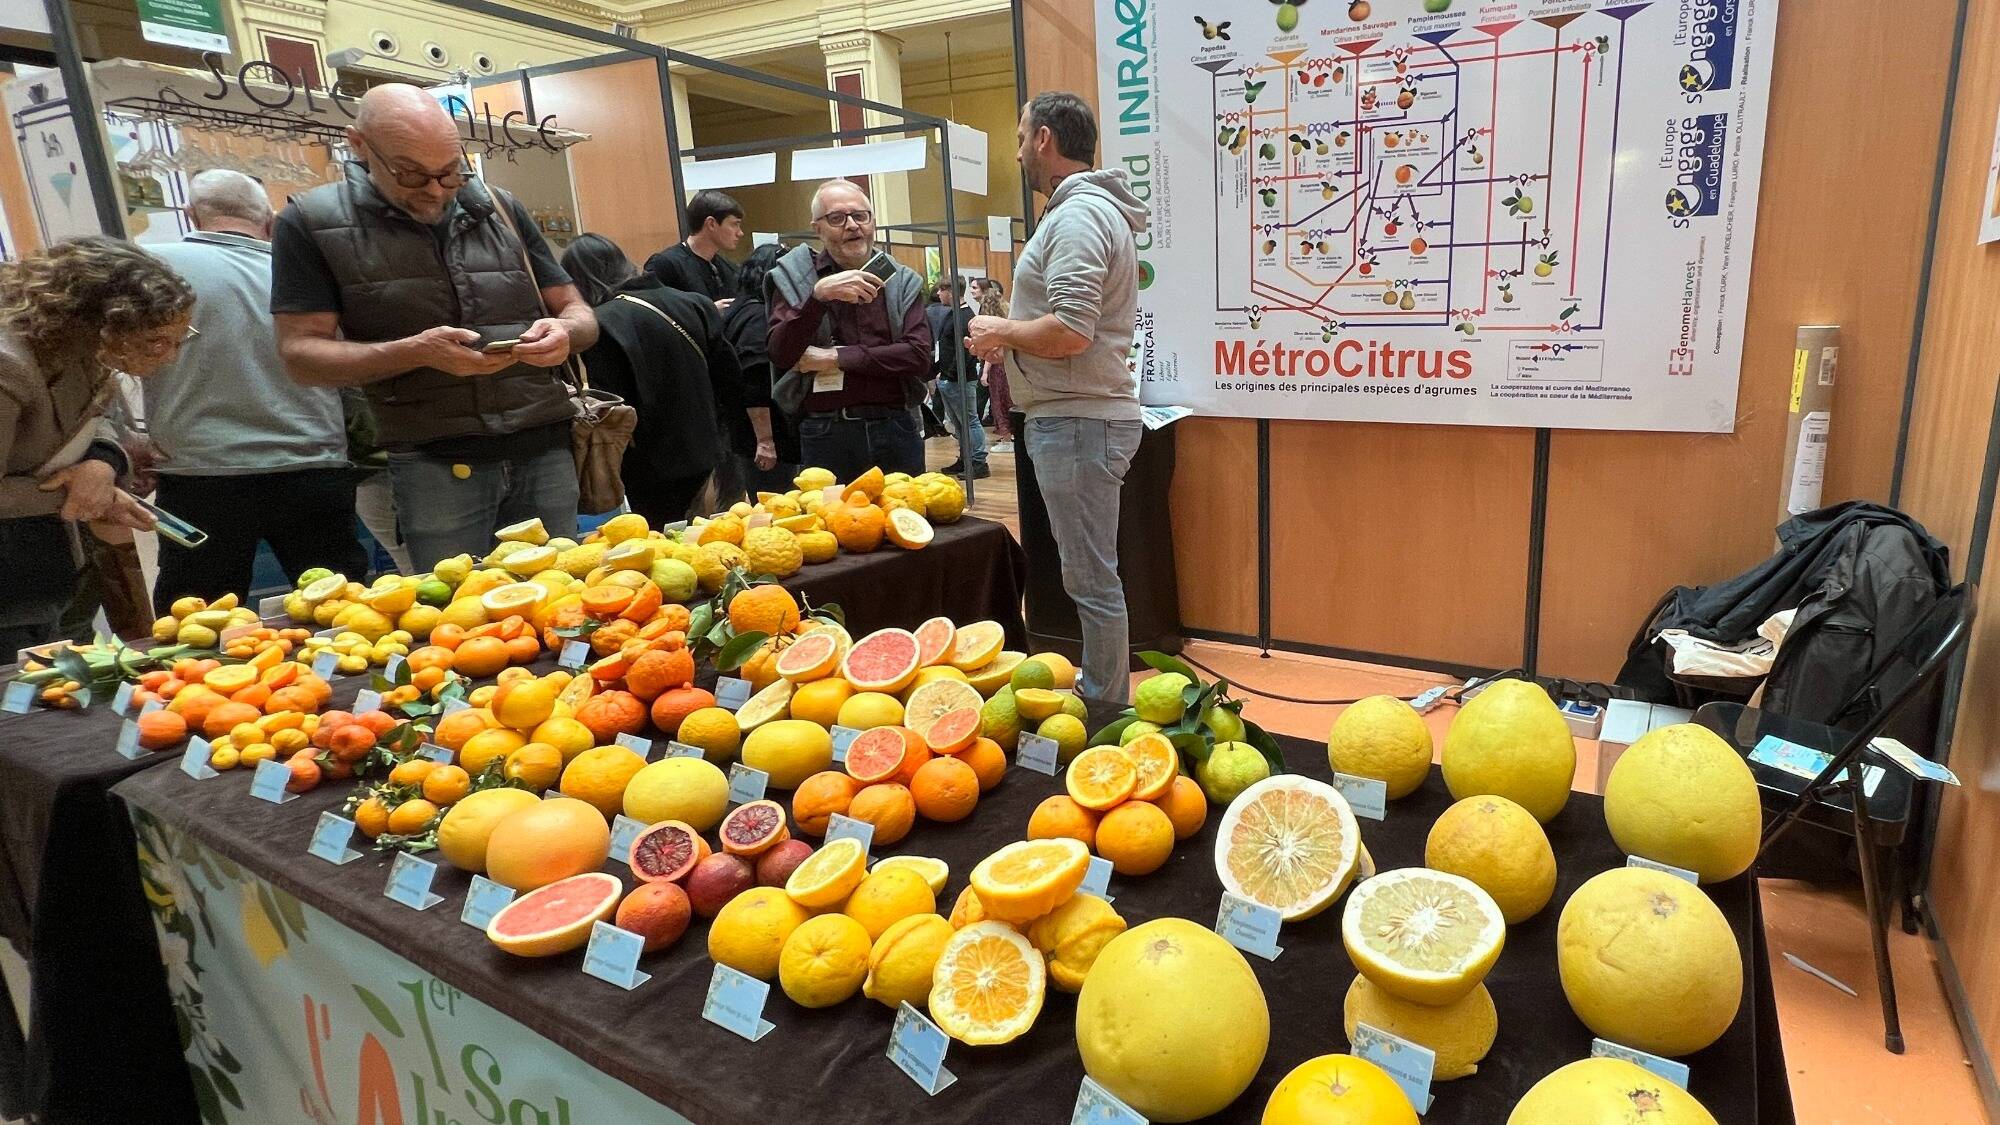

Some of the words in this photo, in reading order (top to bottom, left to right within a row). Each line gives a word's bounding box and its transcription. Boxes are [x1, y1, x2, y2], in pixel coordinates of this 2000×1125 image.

[1407, 10, 1467, 24] Pamplemousses
[1479, 3, 1518, 15] Kumquats
[1673, 0, 1692, 46] l'Europe
[1320, 25, 1361, 36] Mandarines
[1362, 20, 1397, 30] Sauvages
[1725, 26, 1734, 37] en
[1659, 118, 1678, 169] l'Europe
[1705, 114, 1727, 187] Guadeloupe
[1153, 140, 1162, 196] AGRONOMIQUE
[1162, 155, 1171, 218] DÉVELOPPEMENT
[1709, 189, 1719, 200] en
[1676, 260, 1696, 356] GenomeHarvest
[1144, 312, 1156, 382] FRANÇAISE
[1713, 319, 1724, 355] Conception
[1215, 338, 1473, 379] MétroCitrus
[1215, 380, 1233, 391] Les
[1235, 381, 1276, 394] origines
[1278, 382, 1298, 393] des
[1300, 382, 1360, 394] principales
[1363, 383, 1410, 395] espèces
[1413, 384, 1478, 396] d'agrumes
[1499, 391, 1539, 400] coopération
[1587, 392, 1633, 401] Méditerranée
[1500, 384, 1544, 393] cooperazione
